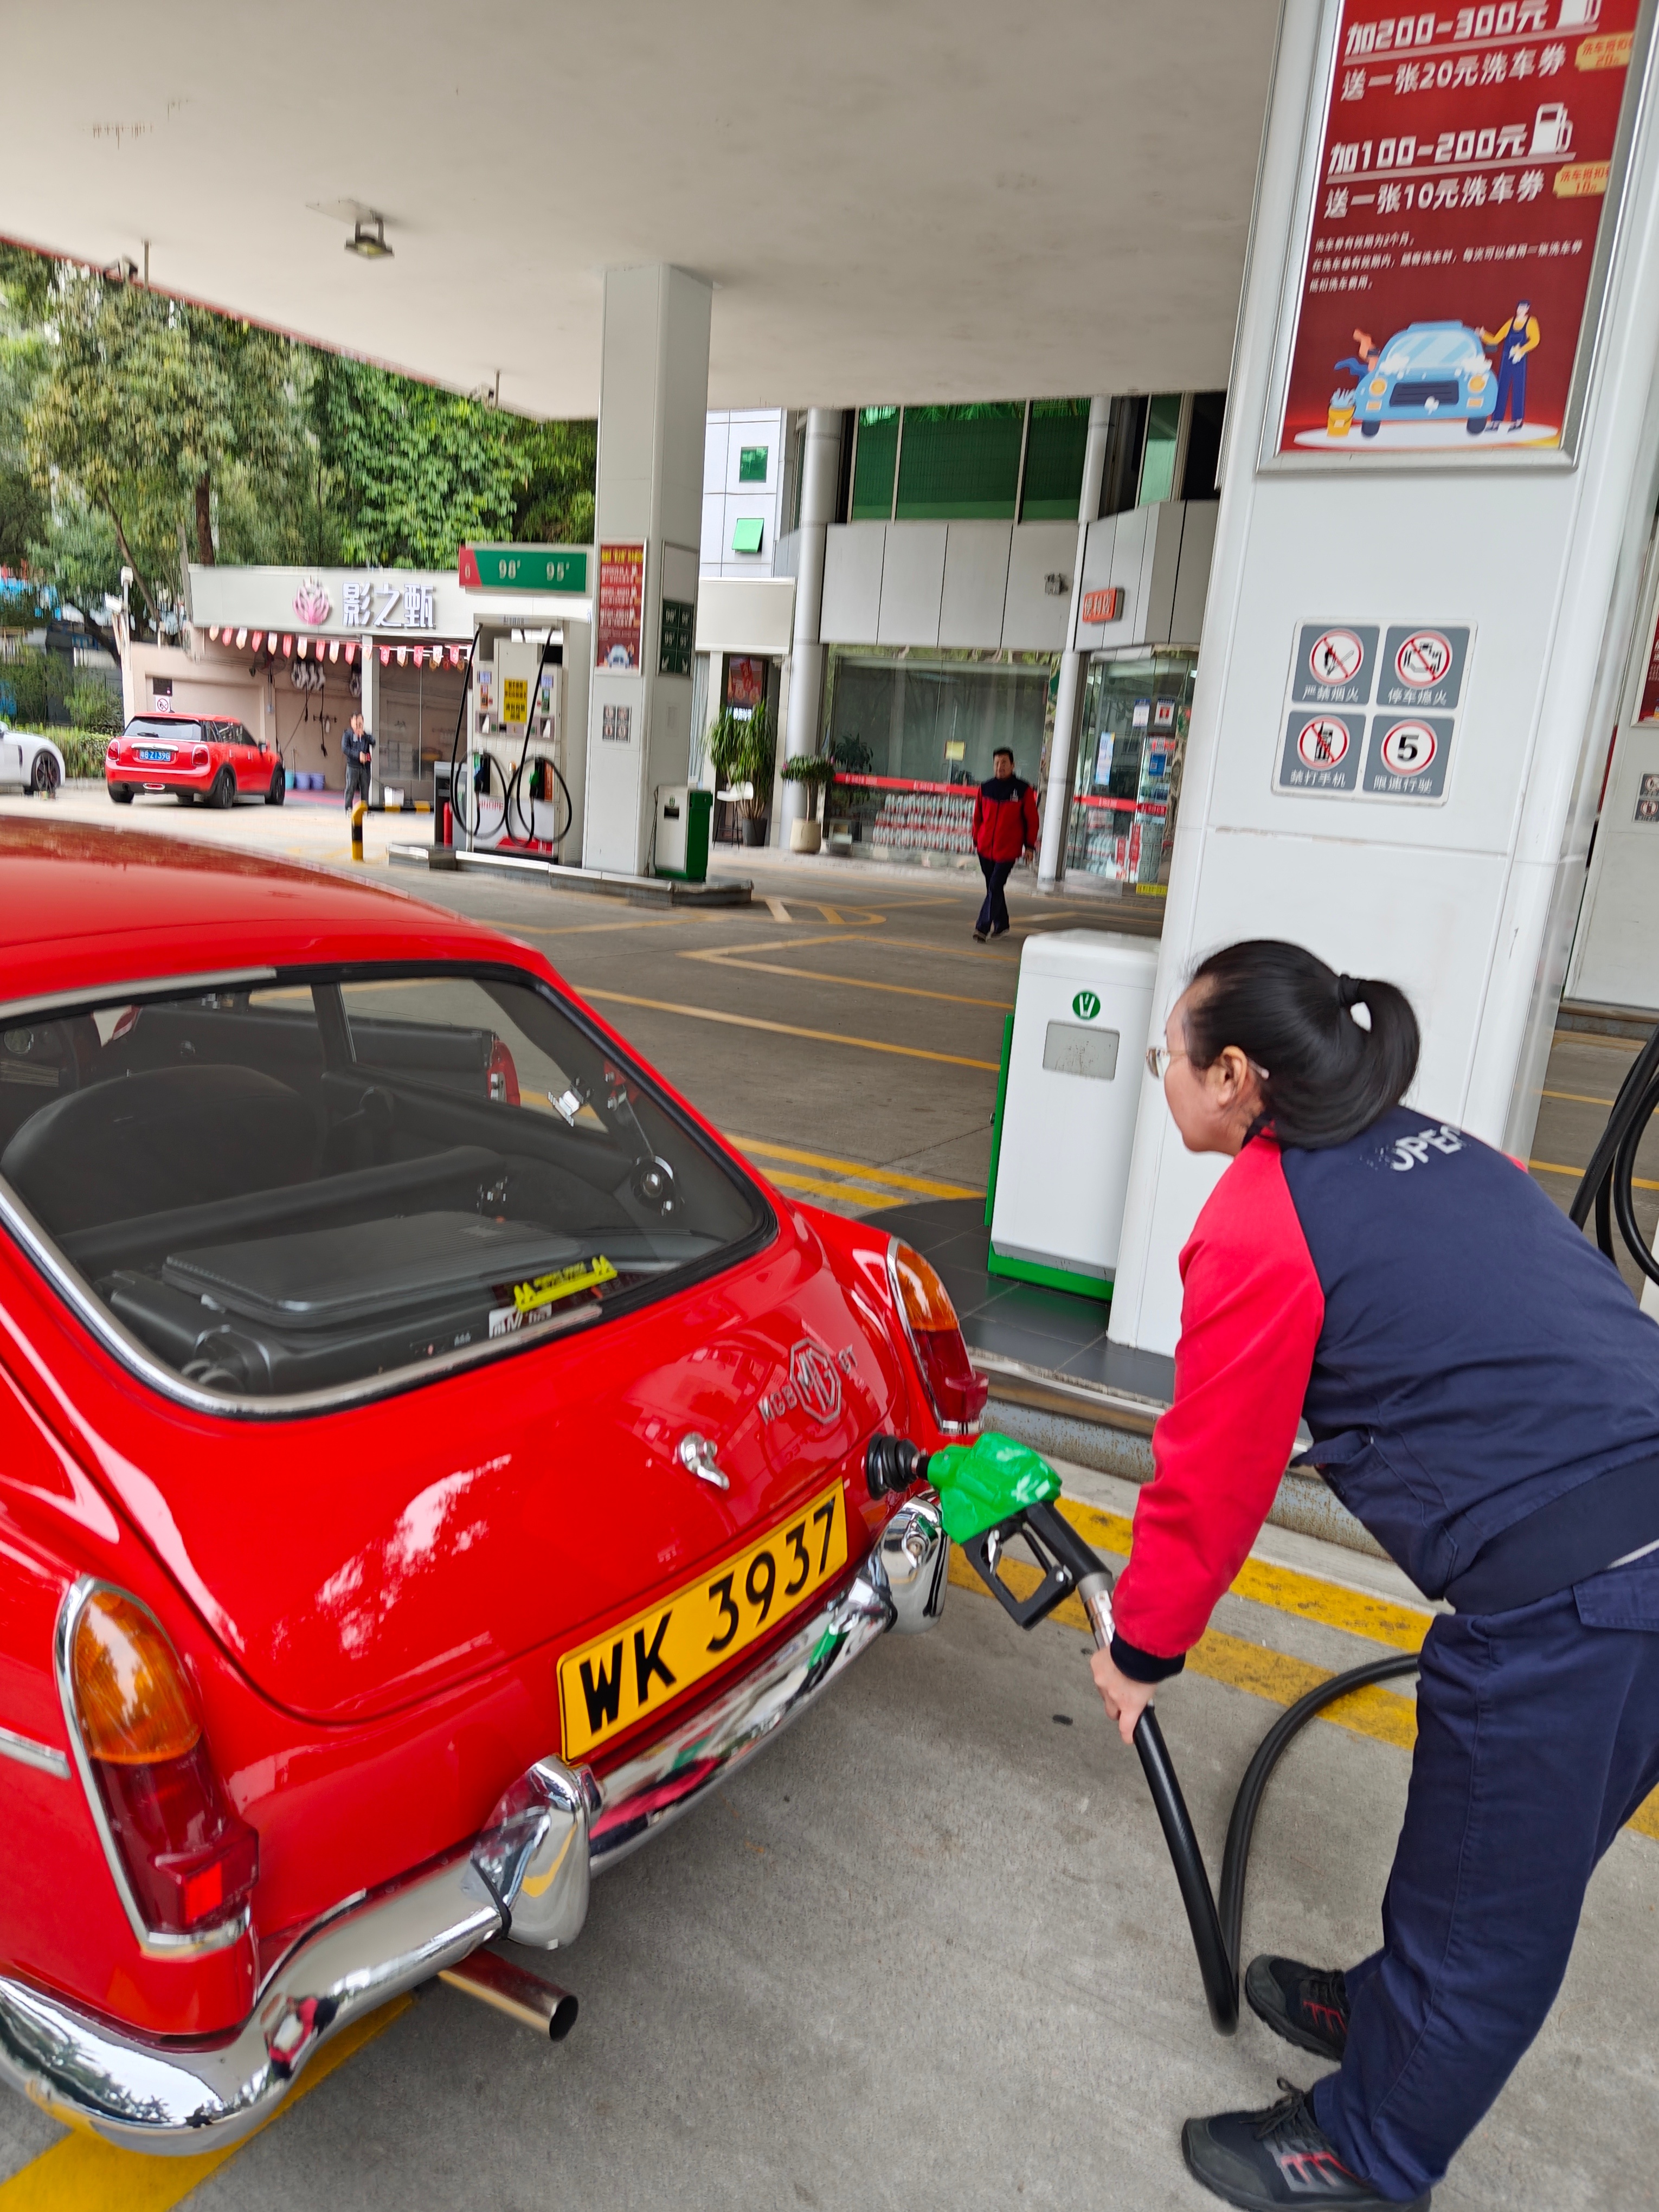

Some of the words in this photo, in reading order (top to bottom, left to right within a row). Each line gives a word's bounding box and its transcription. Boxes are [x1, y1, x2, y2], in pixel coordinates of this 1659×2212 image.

[1345, 0, 1548, 56] 加200-300元
[1340, 42, 1566, 102] 送一张20元洗车券
[1328, 123, 1527, 175] 加100-200元
[1323, 169, 1545, 219] 送一张10元洗车券
[342, 582, 435, 628] 影之甄
[1302, 685, 1359, 703] 严禁烟火
[1388, 686, 1447, 706] 停车熄火
[1397, 734, 1419, 762] 5
[579, 1610, 677, 1737] WK
[706, 1496, 837, 1654] 3937
